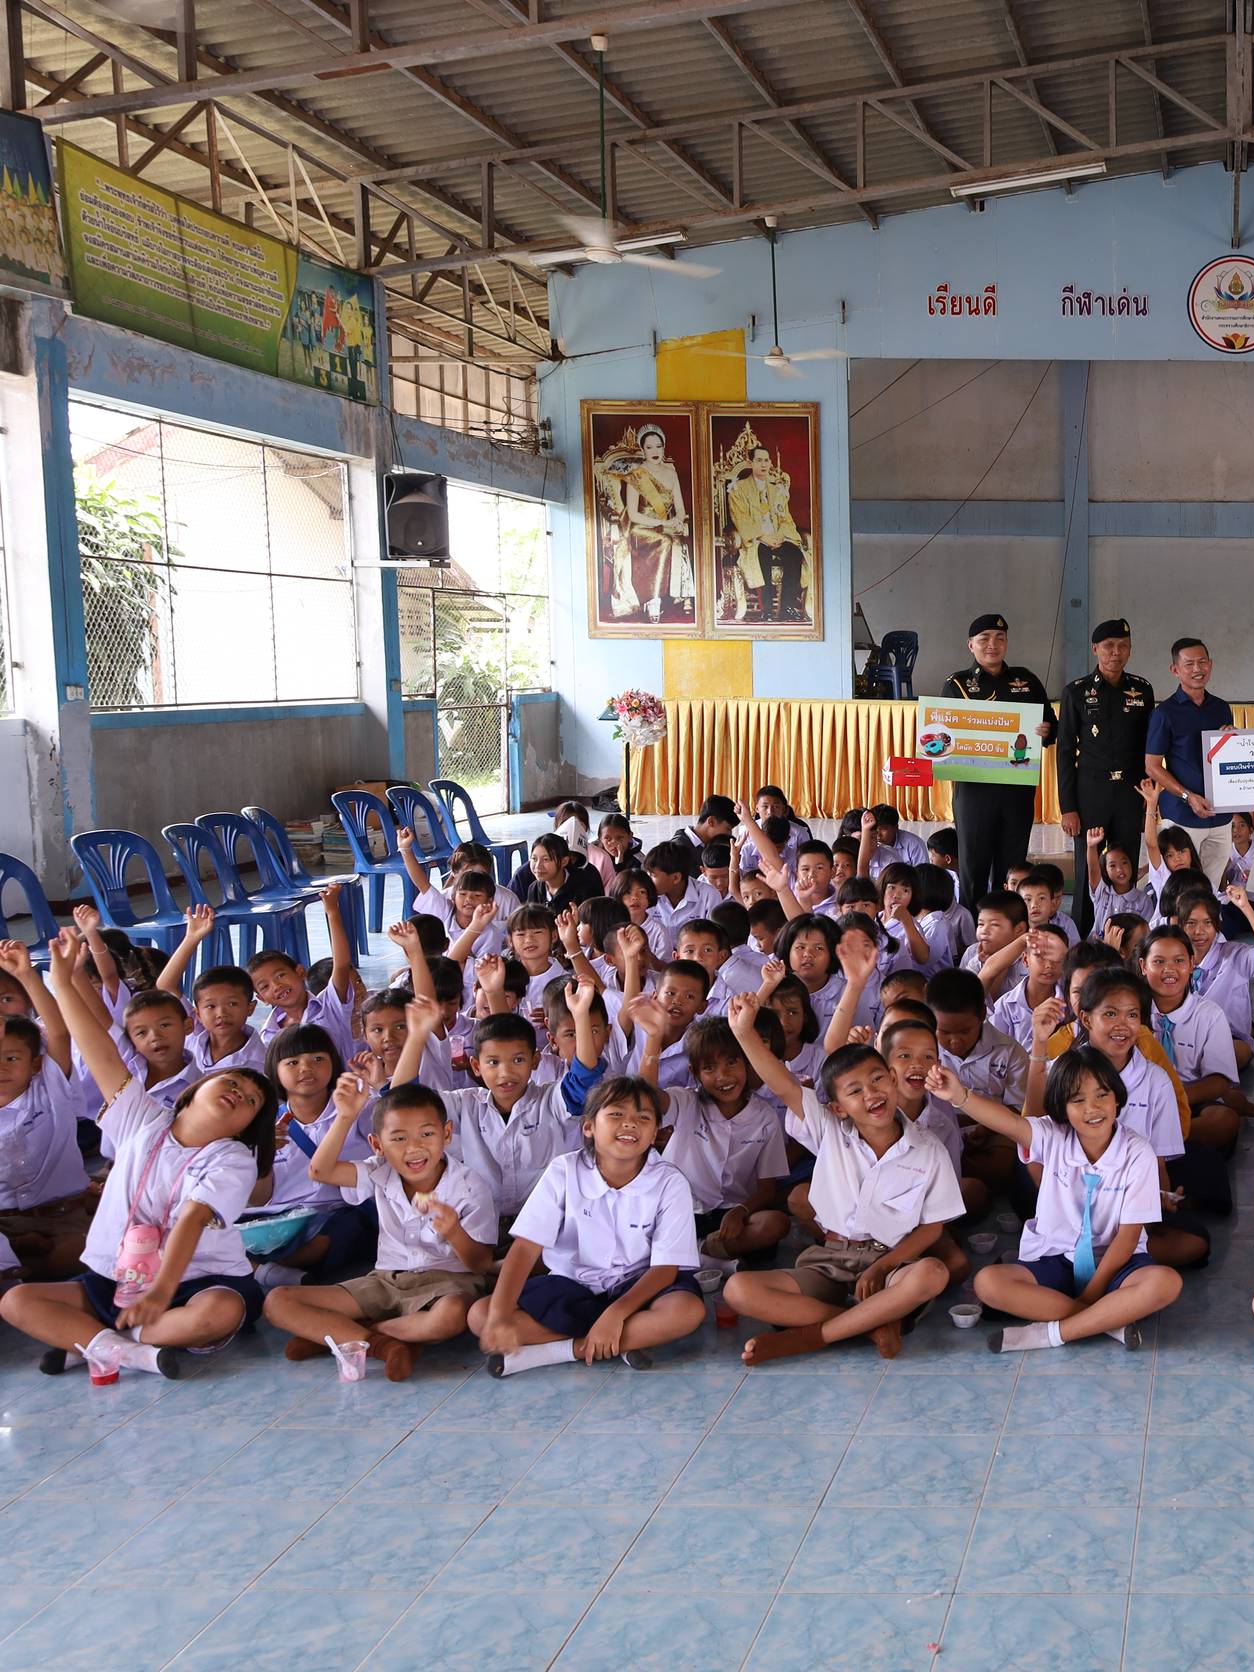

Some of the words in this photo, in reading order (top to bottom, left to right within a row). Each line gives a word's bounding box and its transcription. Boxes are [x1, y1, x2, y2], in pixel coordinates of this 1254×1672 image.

[927, 283, 997, 316] เรียนดี
[1061, 284, 1148, 316] กีฬาเด่น
[974, 742, 994, 752] 300
